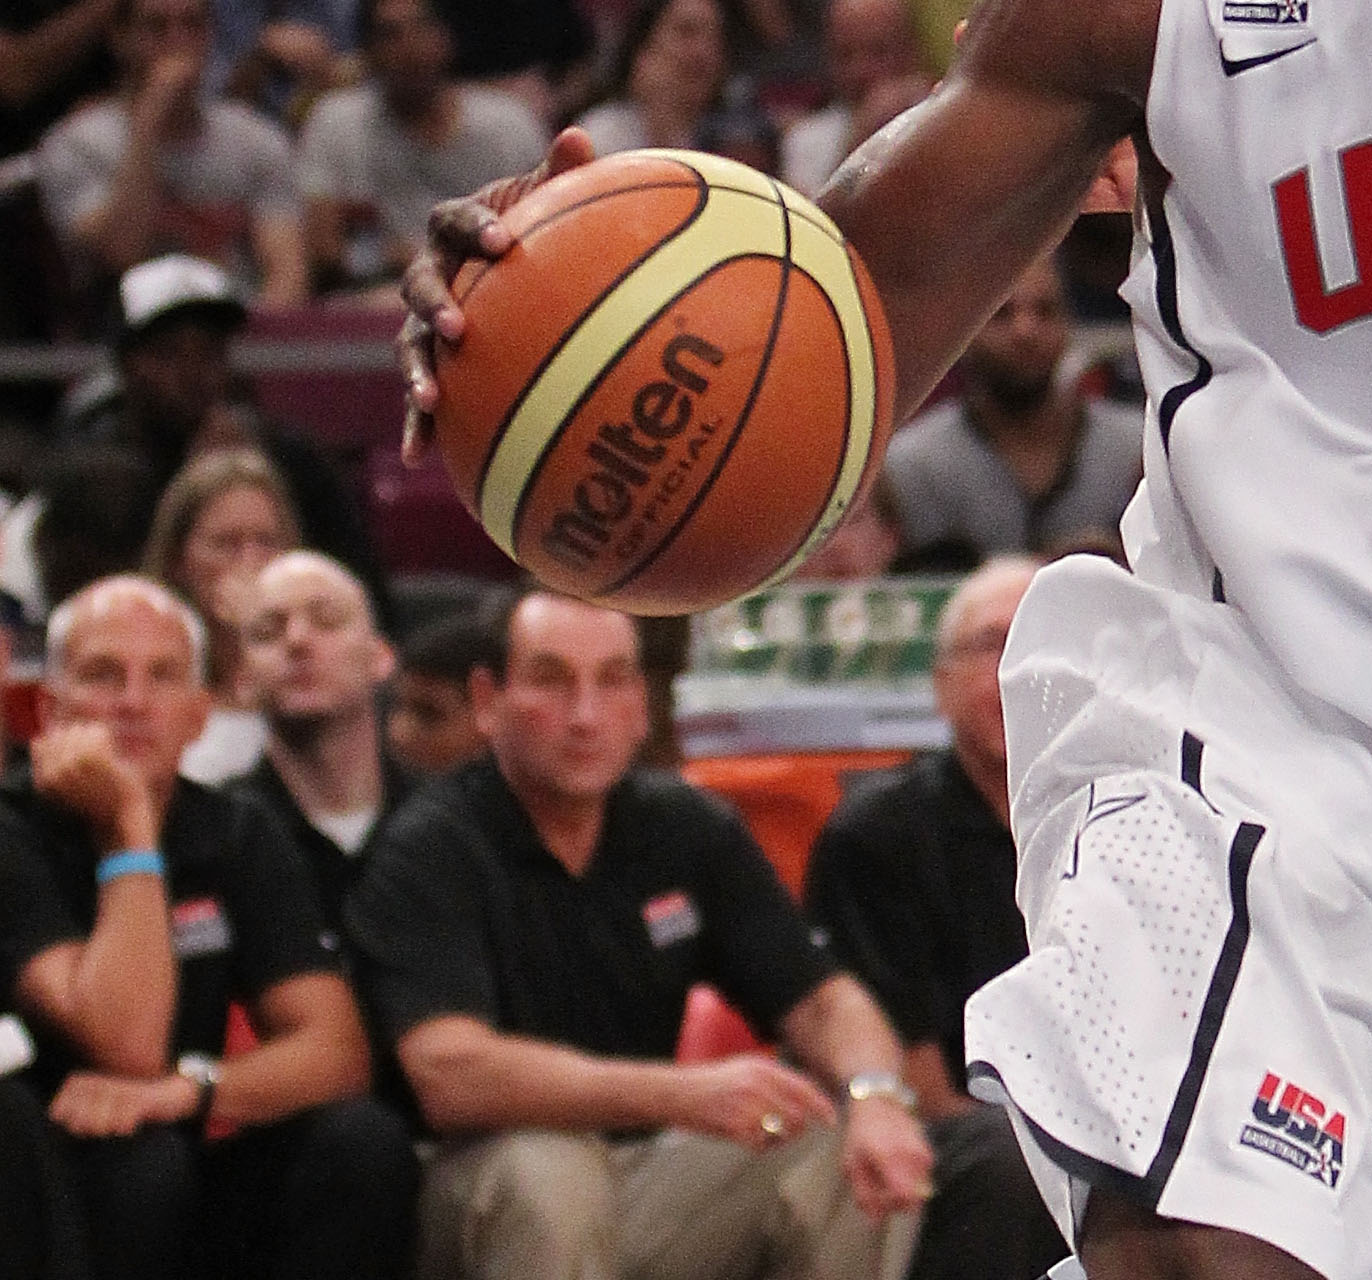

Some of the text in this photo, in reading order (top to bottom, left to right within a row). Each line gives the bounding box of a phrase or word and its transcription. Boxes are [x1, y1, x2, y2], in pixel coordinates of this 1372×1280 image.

[541, 334, 724, 571] molten
[616, 418, 723, 559] OFFICIAL
[1252, 1072, 1346, 1165] USA
